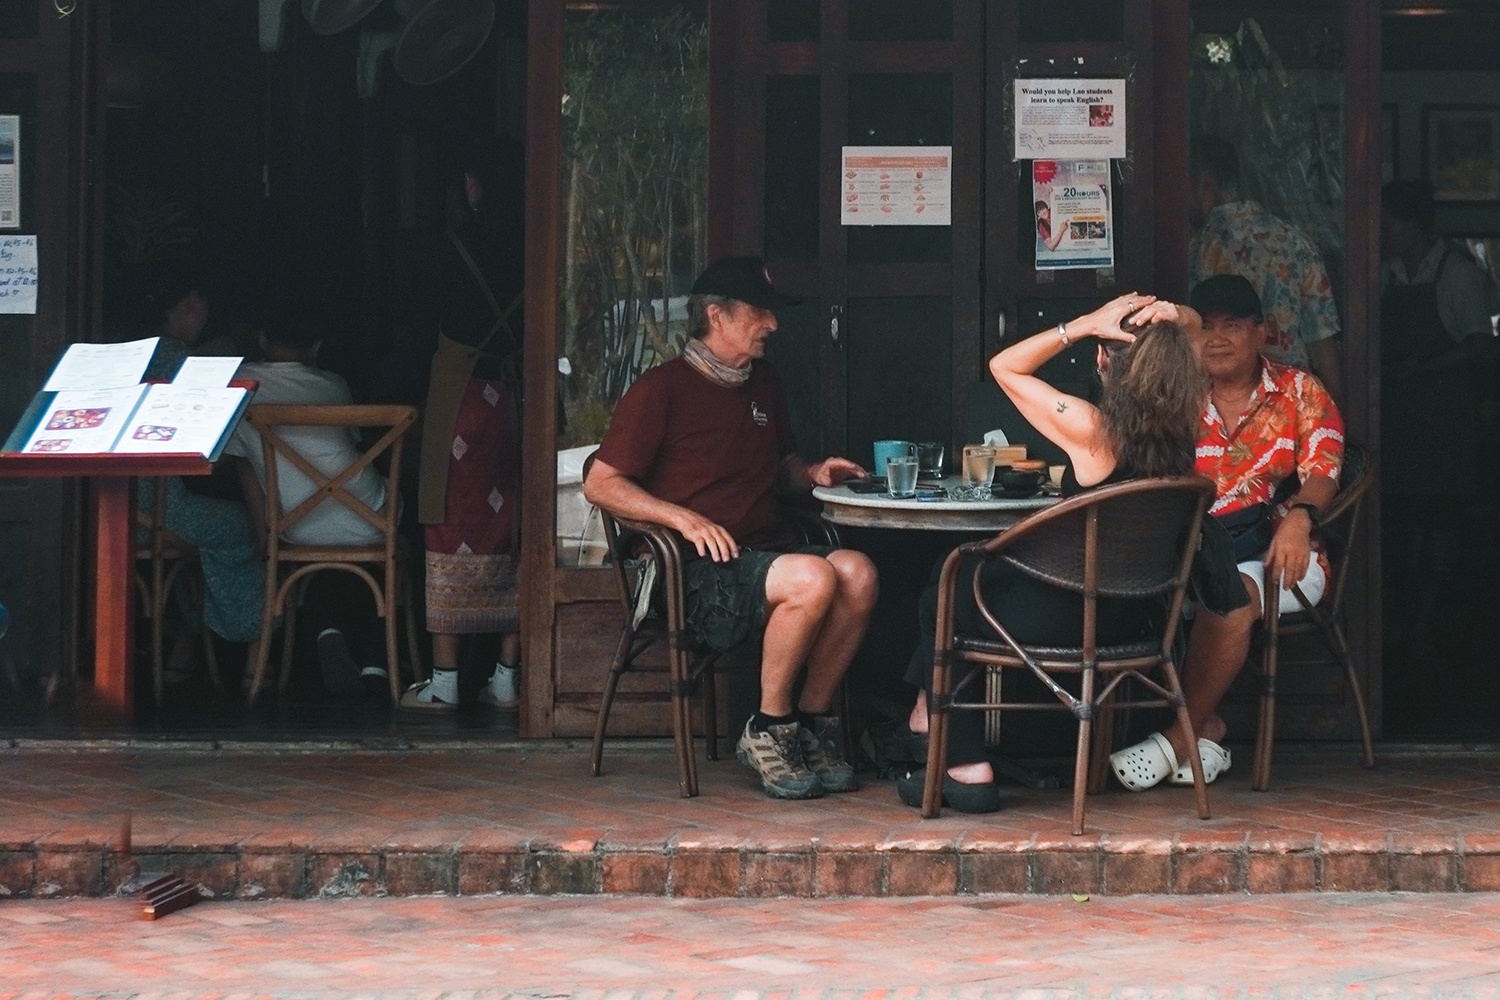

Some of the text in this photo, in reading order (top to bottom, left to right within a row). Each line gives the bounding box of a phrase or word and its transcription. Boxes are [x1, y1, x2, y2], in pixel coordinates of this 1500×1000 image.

[1057, 88, 1071, 96] help
[1056, 97, 1075, 105] speak
[1063, 187, 1077, 197] 20
